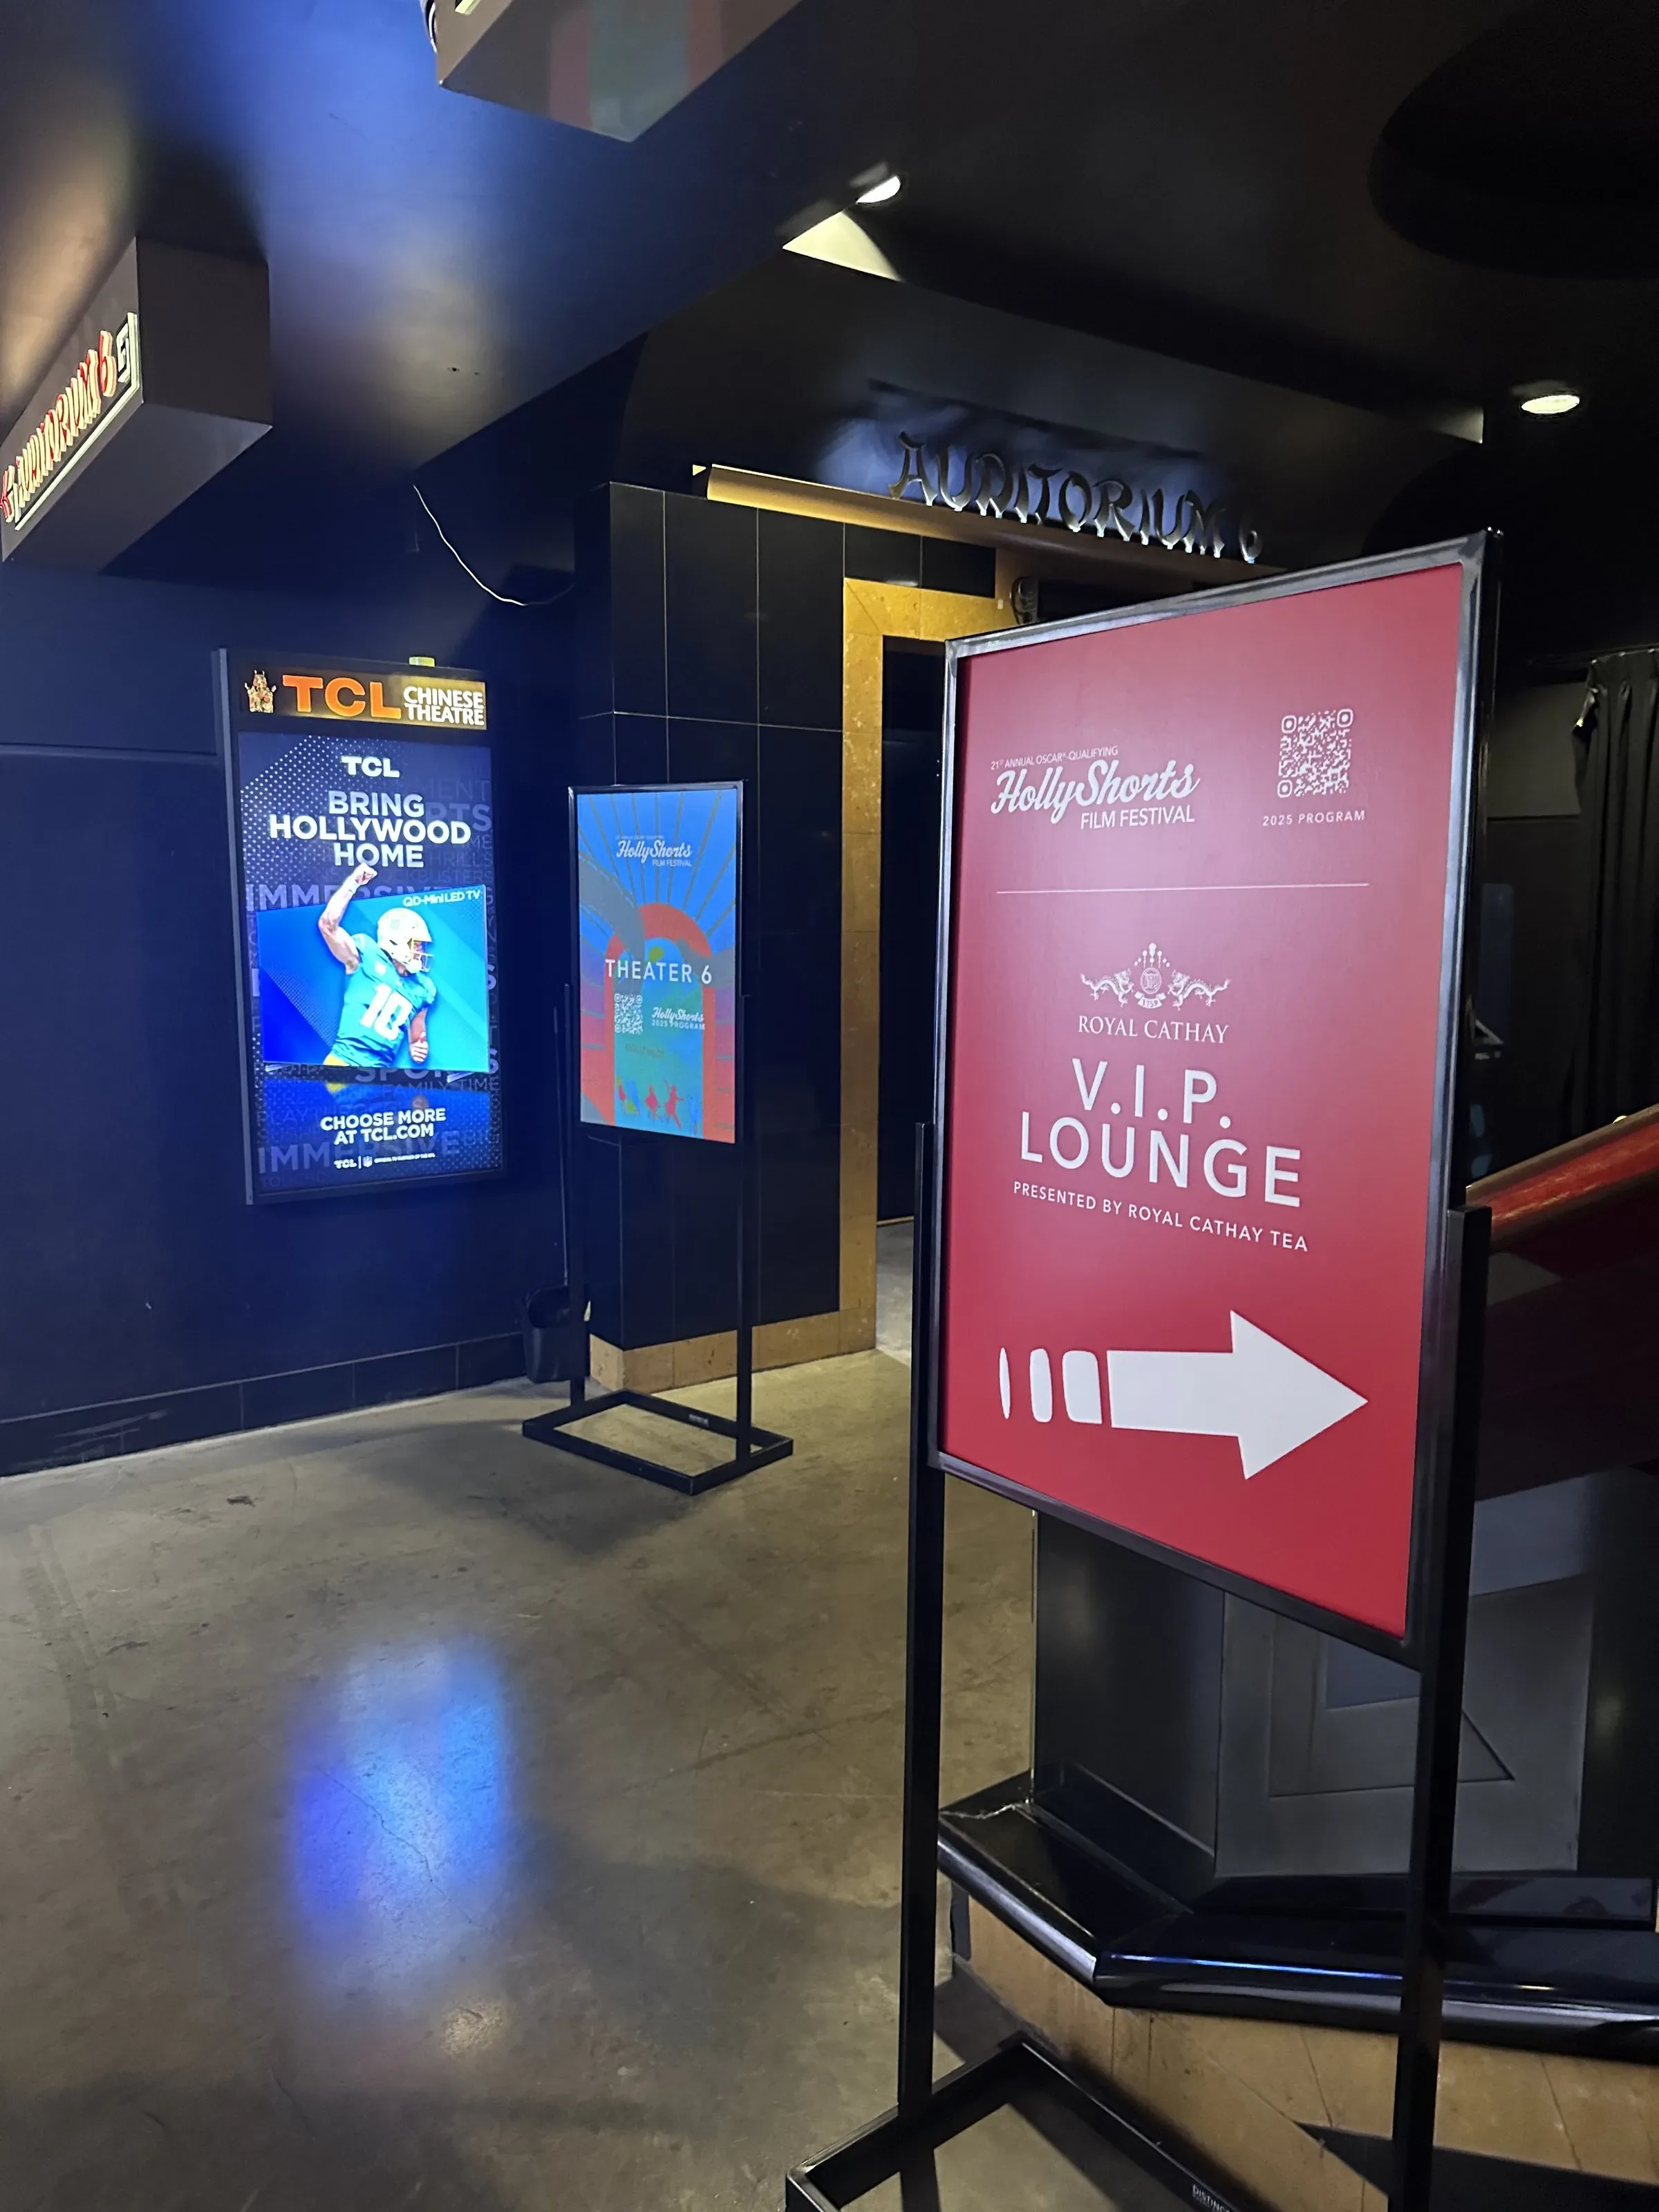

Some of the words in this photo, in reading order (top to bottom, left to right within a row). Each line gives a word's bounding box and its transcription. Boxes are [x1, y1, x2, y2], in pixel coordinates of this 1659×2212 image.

[99, 330, 117, 397] 6
[888, 431, 1226, 559] AUDITORIUM
[1240, 503, 1264, 564] 6
[282, 674, 402, 719] TCL
[403, 686, 485, 709] CHINESE
[404, 702, 485, 726] THEATRE
[341, 756, 400, 778] TCL
[1004, 756, 1034, 769] ANNUAL
[328, 790, 425, 817] BRING
[991, 760, 1200, 824] HollyShorts
[269, 814, 471, 844] HOLLYWOOD
[1080, 809, 1115, 830] FILM
[1120, 805, 1194, 827] FESTIVAL
[1262, 816, 1293, 826] 2025
[1298, 809, 1365, 825] PROGRAM
[333, 843, 424, 868] HOME
[616, 839, 693, 863] HollyShorts
[466, 889, 481, 900] TV
[605, 959, 692, 982] THEATER
[701, 965, 712, 984] 6
[359, 984, 413, 1040] 10
[652, 1006, 704, 1024] HollyShorts
[671, 1022, 705, 1031] PROGRAM
[1078, 1015, 1138, 1038] ROYAL
[1143, 1020, 1229, 1044] CATHAY
[1071, 1058, 1232, 1129] V.I.P.
[320, 1111, 394, 1131] CHOOSE
[397, 1107, 447, 1125] MORE
[333, 1130, 357, 1145] AT
[359, 1123, 434, 1143] TCL.COM
[334, 1159, 357, 1169] TCL
[1020, 1111, 1301, 1208] LOUNGE
[1013, 1180, 1096, 1210] PRESENTED
[1103, 1199, 1123, 1215] BY
[1128, 1204, 1183, 1228] ROYAL
[1190, 1215, 1264, 1243] CATHAY
[1269, 1230, 1309, 1253] TEA
